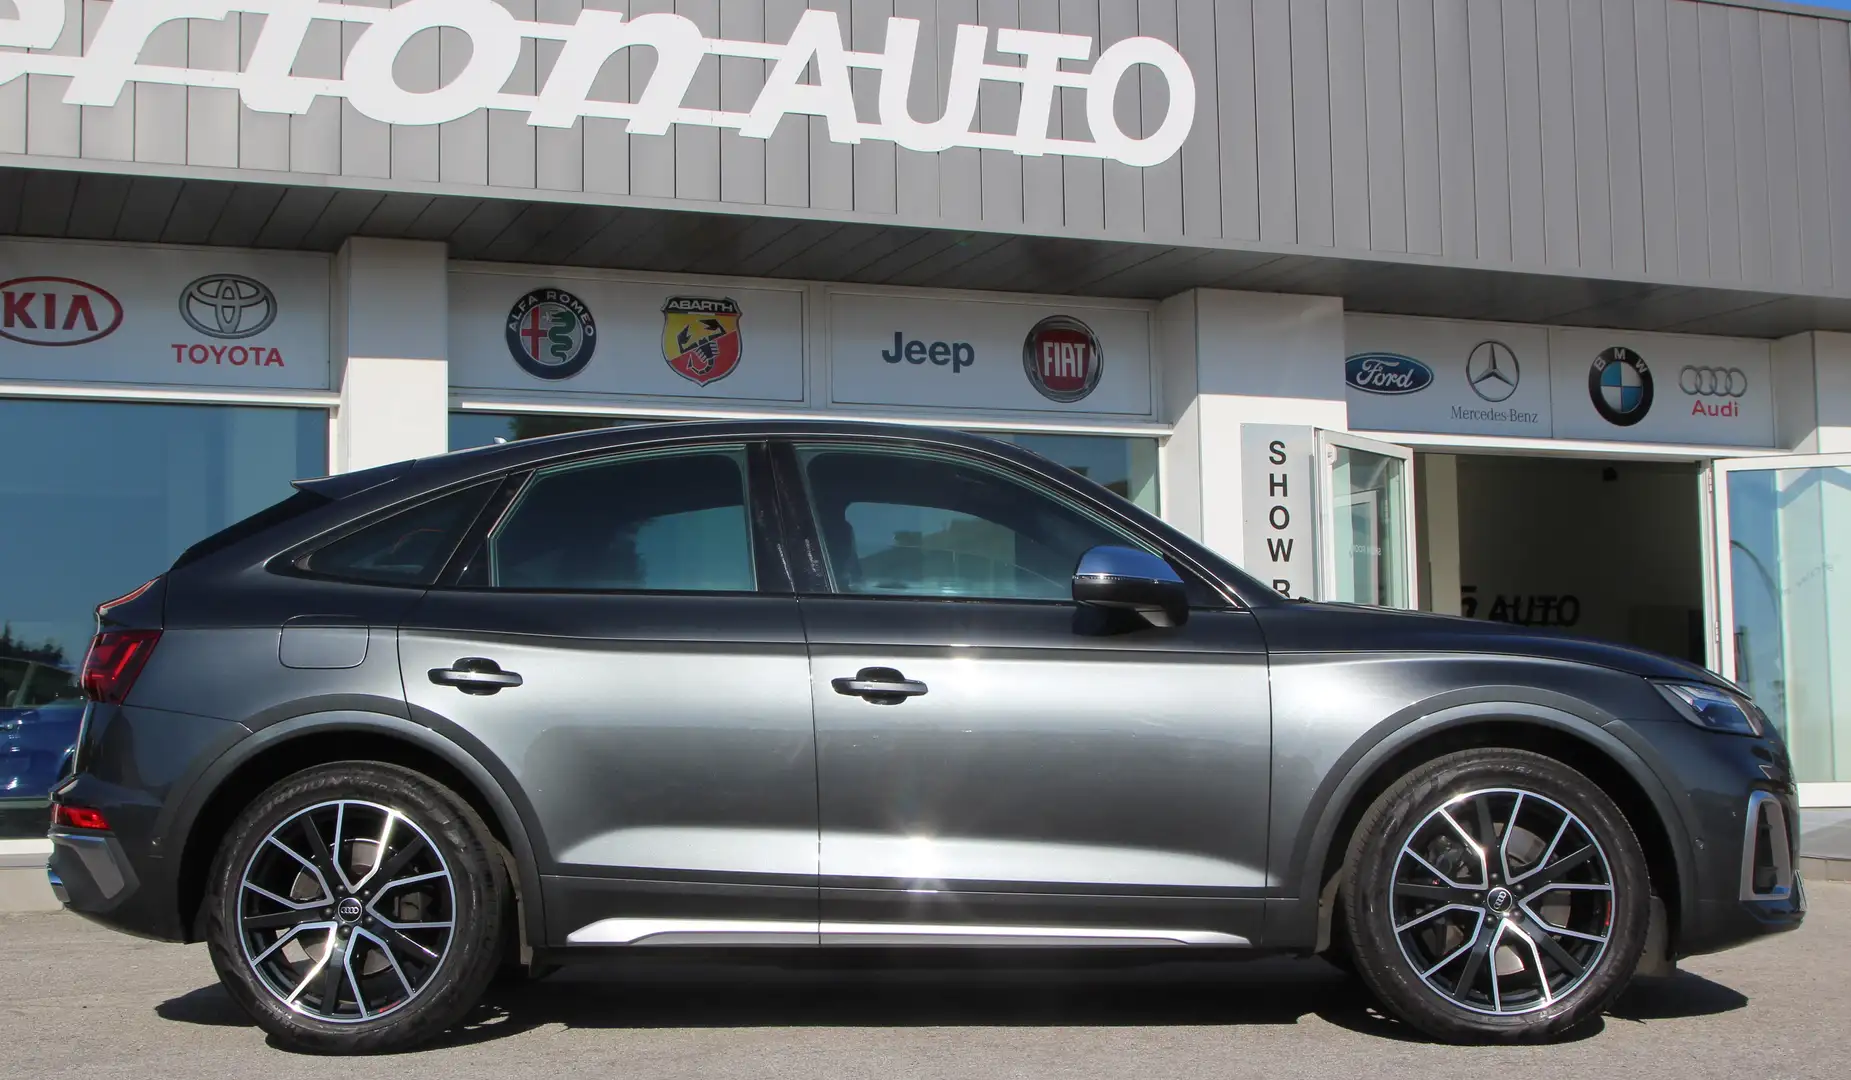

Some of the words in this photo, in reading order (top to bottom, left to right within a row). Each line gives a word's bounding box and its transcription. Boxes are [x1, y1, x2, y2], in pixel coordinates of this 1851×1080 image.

[739, 9, 1196, 167] AUTO
[2, 291, 98, 331] KIA
[508, 294, 539, 332] ALFA
[546, 290, 595, 337] ROMEO
[668, 300, 734, 312] ABARTH
[171, 344, 285, 367] TOYOTA
[881, 331, 975, 373] Jeep
[1043, 341, 1086, 378] FIAT
[1593, 348, 1648, 374] BMW
[1356, 359, 1415, 388] Ford
[1451, 405, 1539, 424] Mercedes-Benz
[1691, 400, 1739, 417] Audi
[1267, 440, 1294, 563] SHOW
[1488, 594, 1580, 627] AUTO
